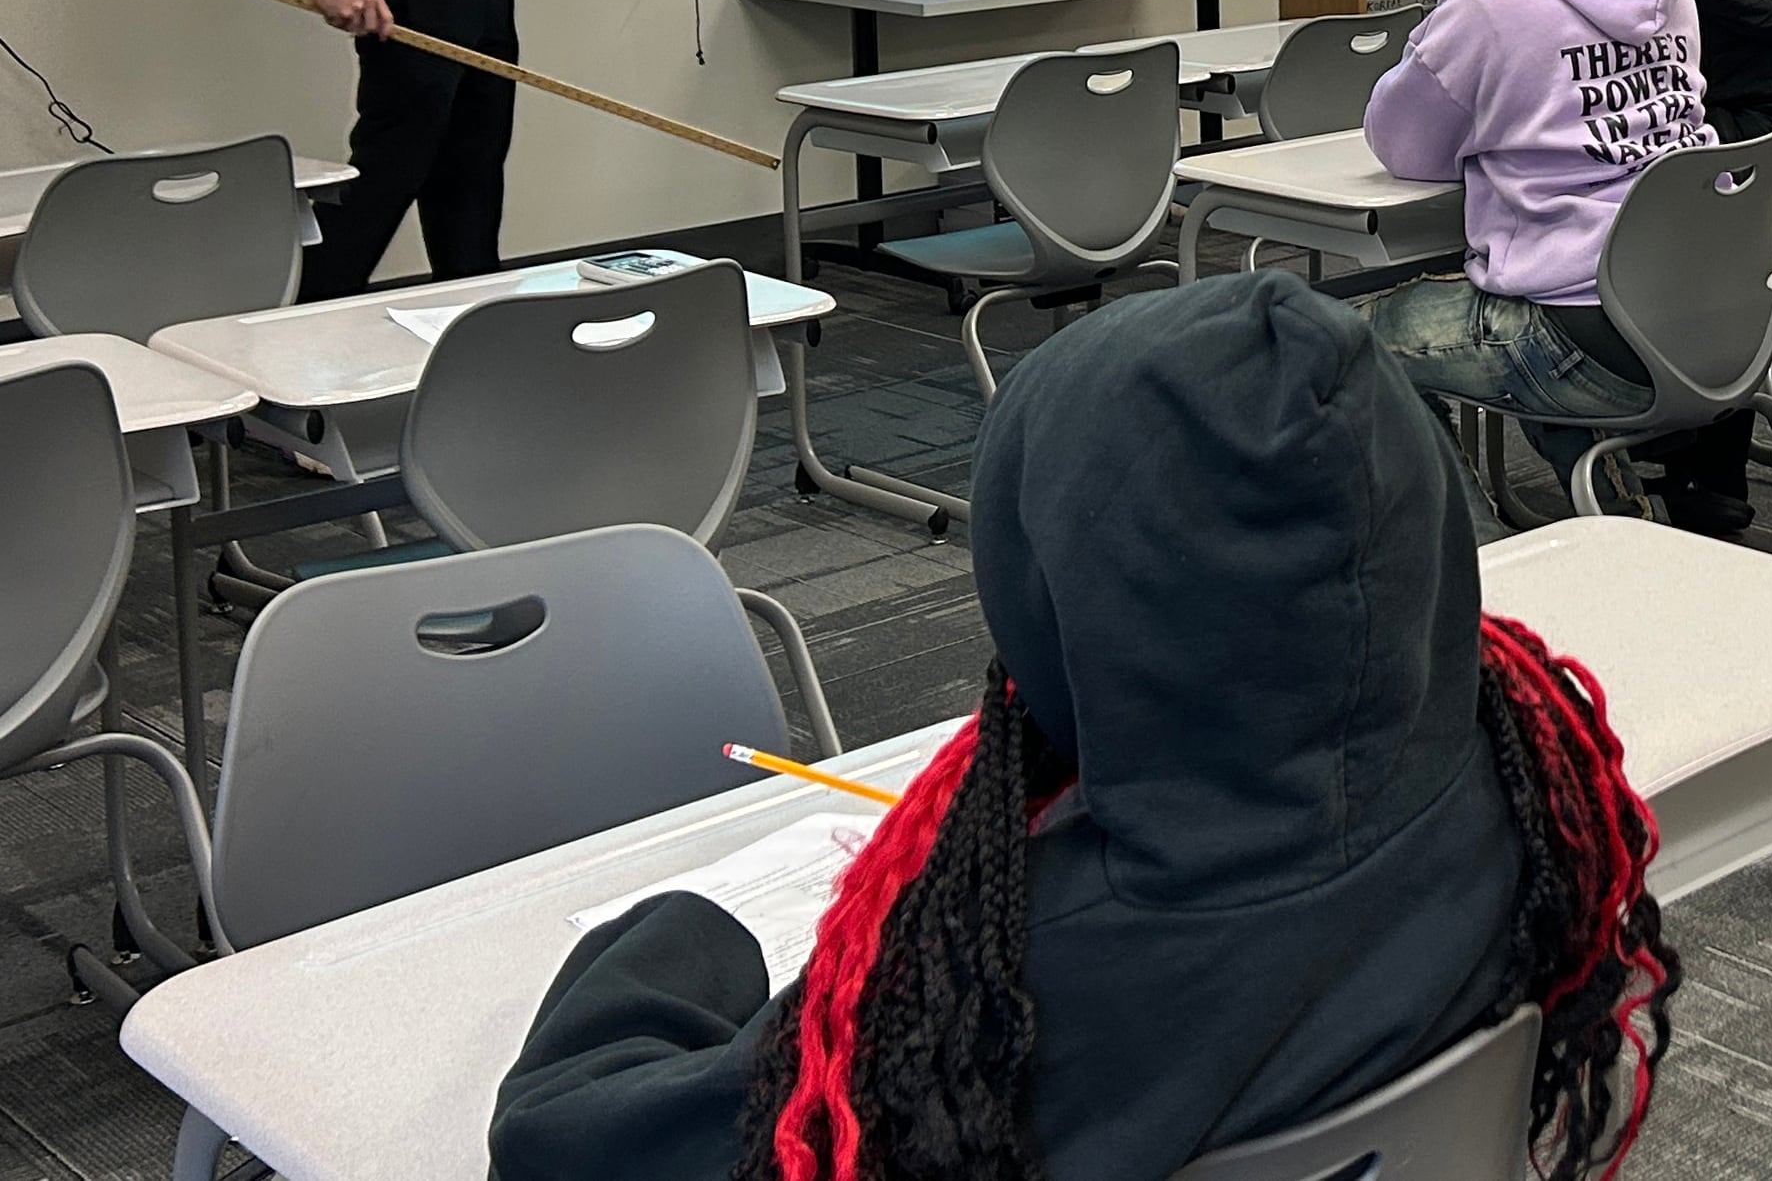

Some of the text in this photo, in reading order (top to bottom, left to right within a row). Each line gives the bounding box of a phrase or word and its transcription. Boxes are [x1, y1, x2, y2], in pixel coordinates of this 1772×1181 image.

[1560, 33, 1687, 81] THERE'S
[1578, 64, 1694, 117] POWER
[1584, 95, 1696, 143] IN THE
